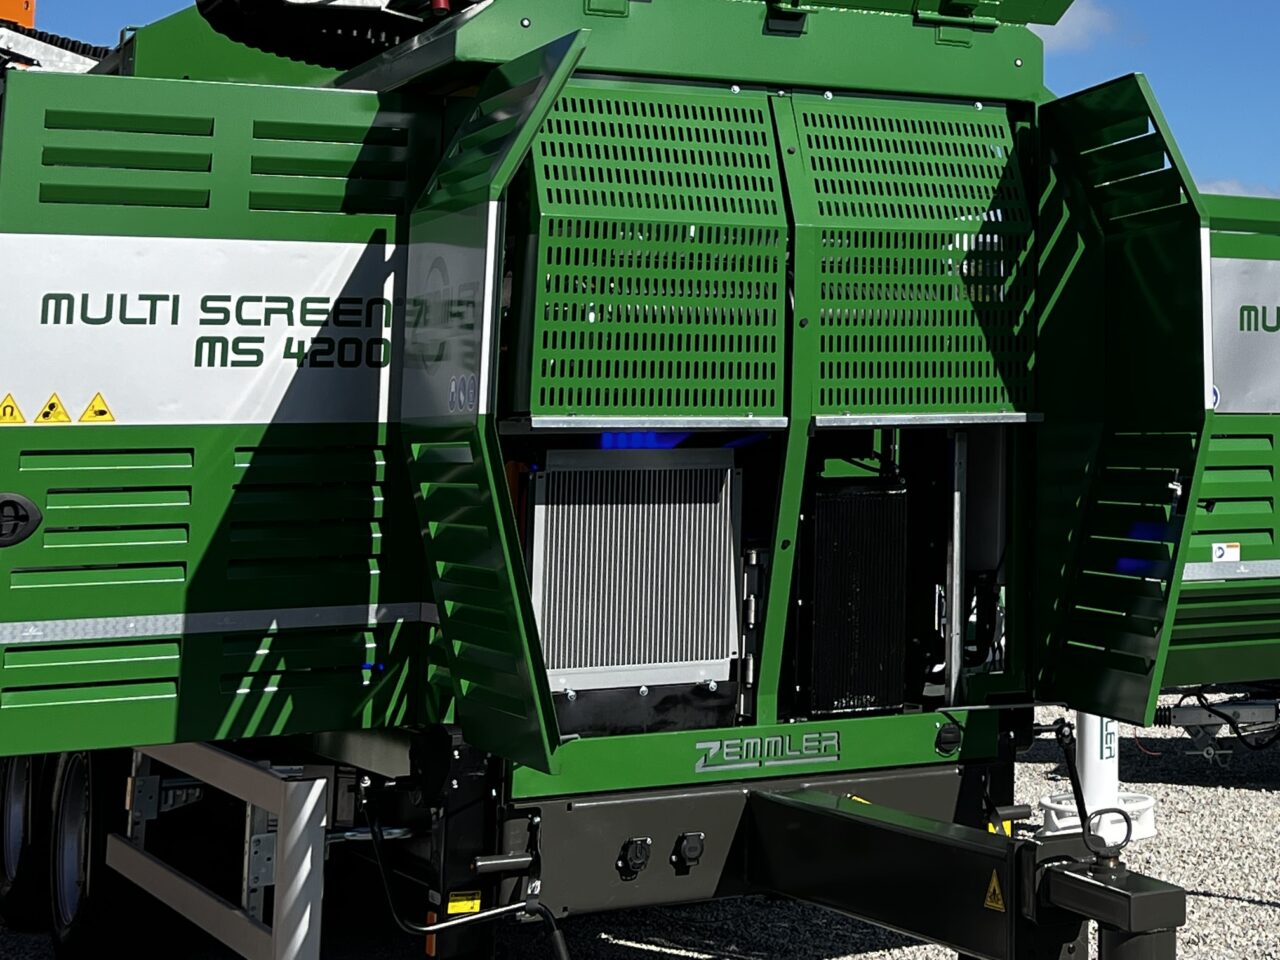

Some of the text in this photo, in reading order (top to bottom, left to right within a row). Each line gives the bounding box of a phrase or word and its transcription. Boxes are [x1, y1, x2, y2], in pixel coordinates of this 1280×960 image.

[40, 292, 180, 326] MULTI
[194, 335, 392, 369] MS 4200
[695, 730, 840, 773] ZEMMLER
